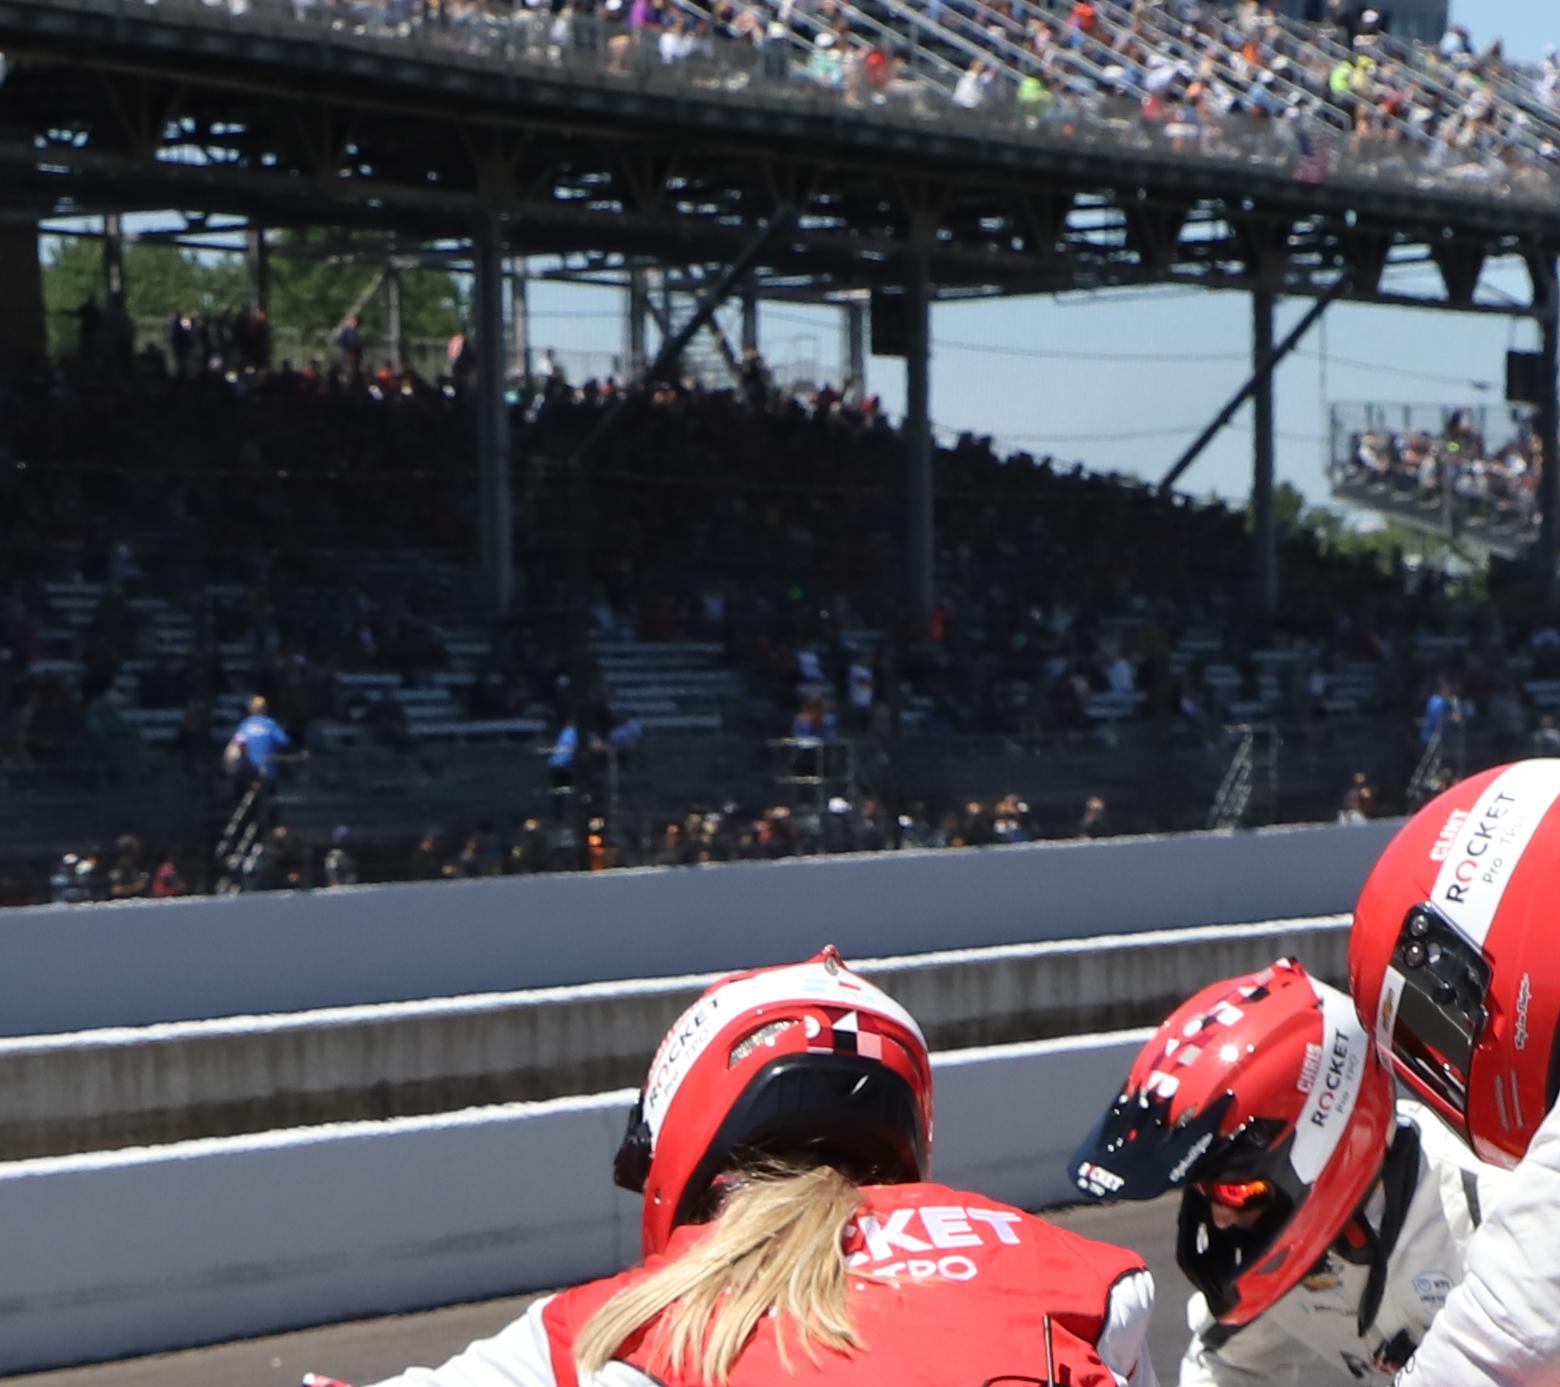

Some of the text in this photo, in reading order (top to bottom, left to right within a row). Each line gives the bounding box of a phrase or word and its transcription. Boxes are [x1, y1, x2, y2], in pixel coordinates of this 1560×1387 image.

[1430, 808, 1468, 861] CLINT
[1445, 791, 1516, 904] ROCKET
[1482, 856, 1504, 884] Pro
[648, 996, 721, 1109] ROCKET
[1310, 1028, 1351, 1128] ROCKET
